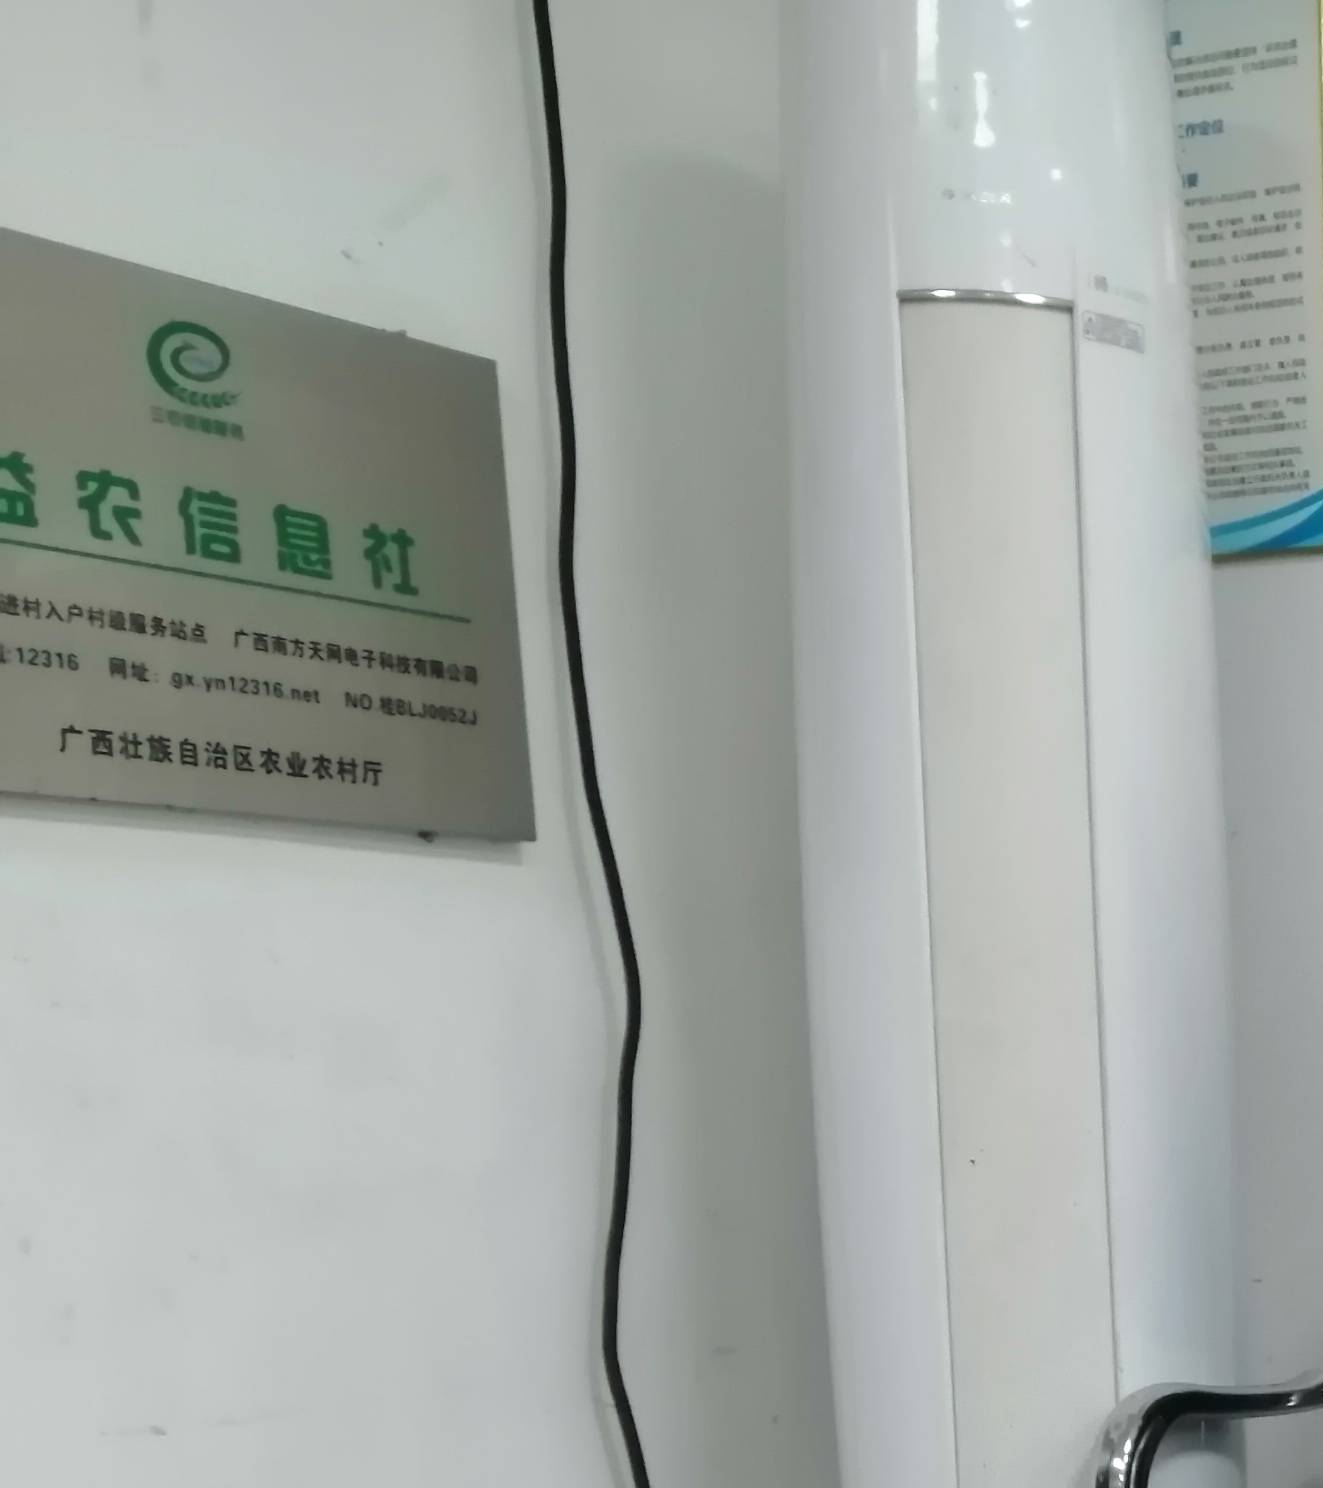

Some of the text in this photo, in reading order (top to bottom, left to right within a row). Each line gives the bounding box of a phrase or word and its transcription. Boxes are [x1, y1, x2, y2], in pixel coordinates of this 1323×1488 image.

[59, 725, 383, 786] 广西壮族自治区农业农村厅
